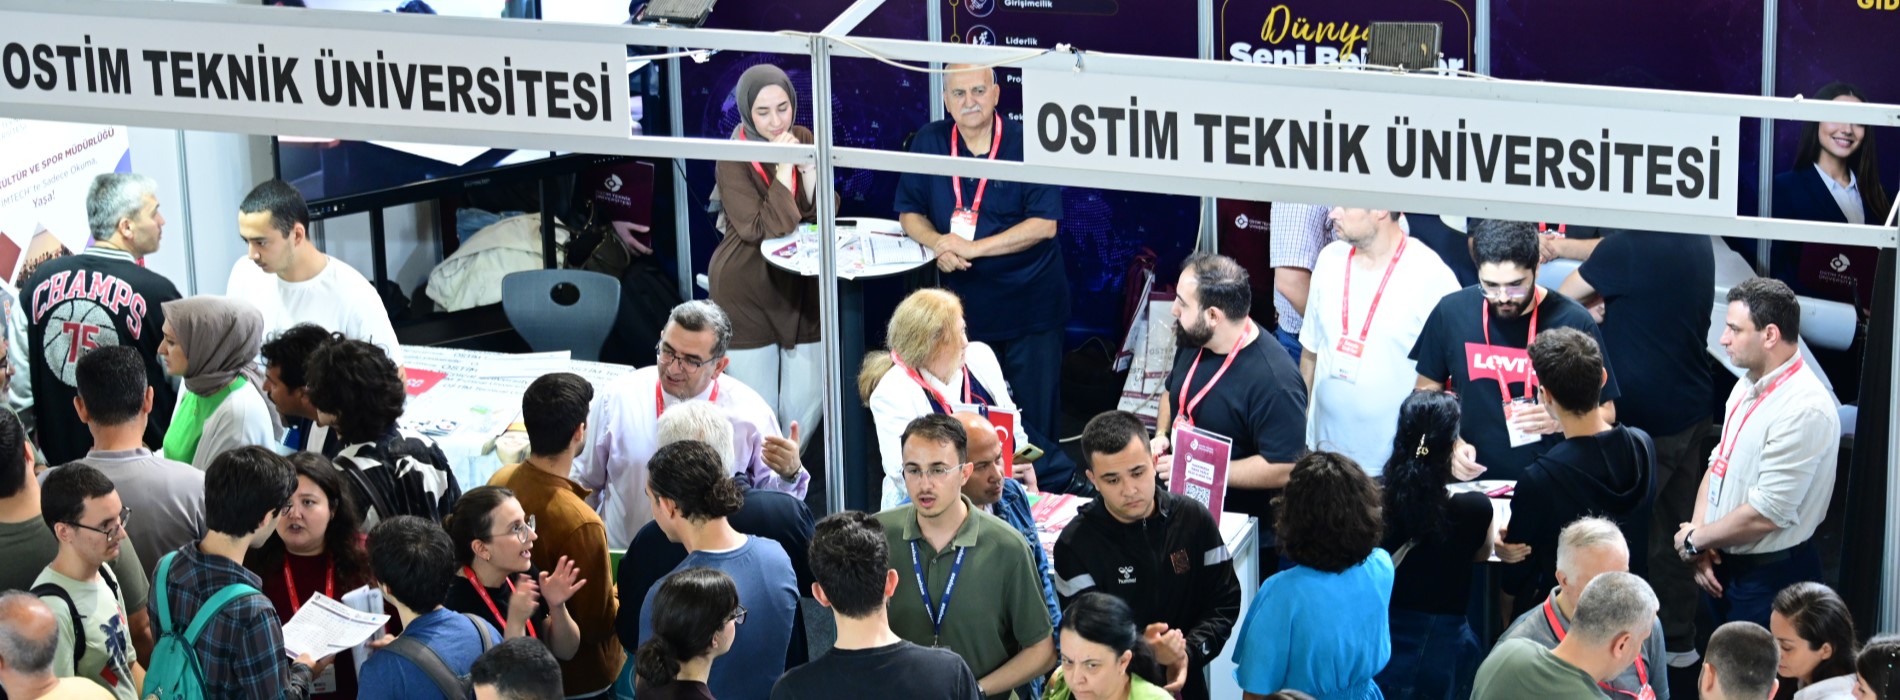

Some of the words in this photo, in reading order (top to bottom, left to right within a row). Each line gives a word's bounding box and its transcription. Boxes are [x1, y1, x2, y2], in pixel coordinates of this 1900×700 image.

[1005, 37, 1038, 45] Liderlik
[1230, 42, 1306, 65] Seni
[2, 34, 132, 95] OSTİM
[142, 43, 304, 105] TEKNİK
[314, 48, 612, 122] ÜNİVERSİTESİ
[0, 167, 28, 190] ÜLTÜR
[29, 163, 40, 174] VE
[42, 152, 63, 170] SPOR
[65, 127, 115, 159] MÜDÜRLÜĞÜ
[1037, 96, 1178, 160] OSTİM
[1194, 109, 1371, 175] TEKNİK
[1387, 116, 1720, 200] ÜNİVERSİTESİ
[32, 189, 56, 208] Yaşa!
[32, 269, 147, 340] CHAMPS
[62, 322, 101, 363] 75
